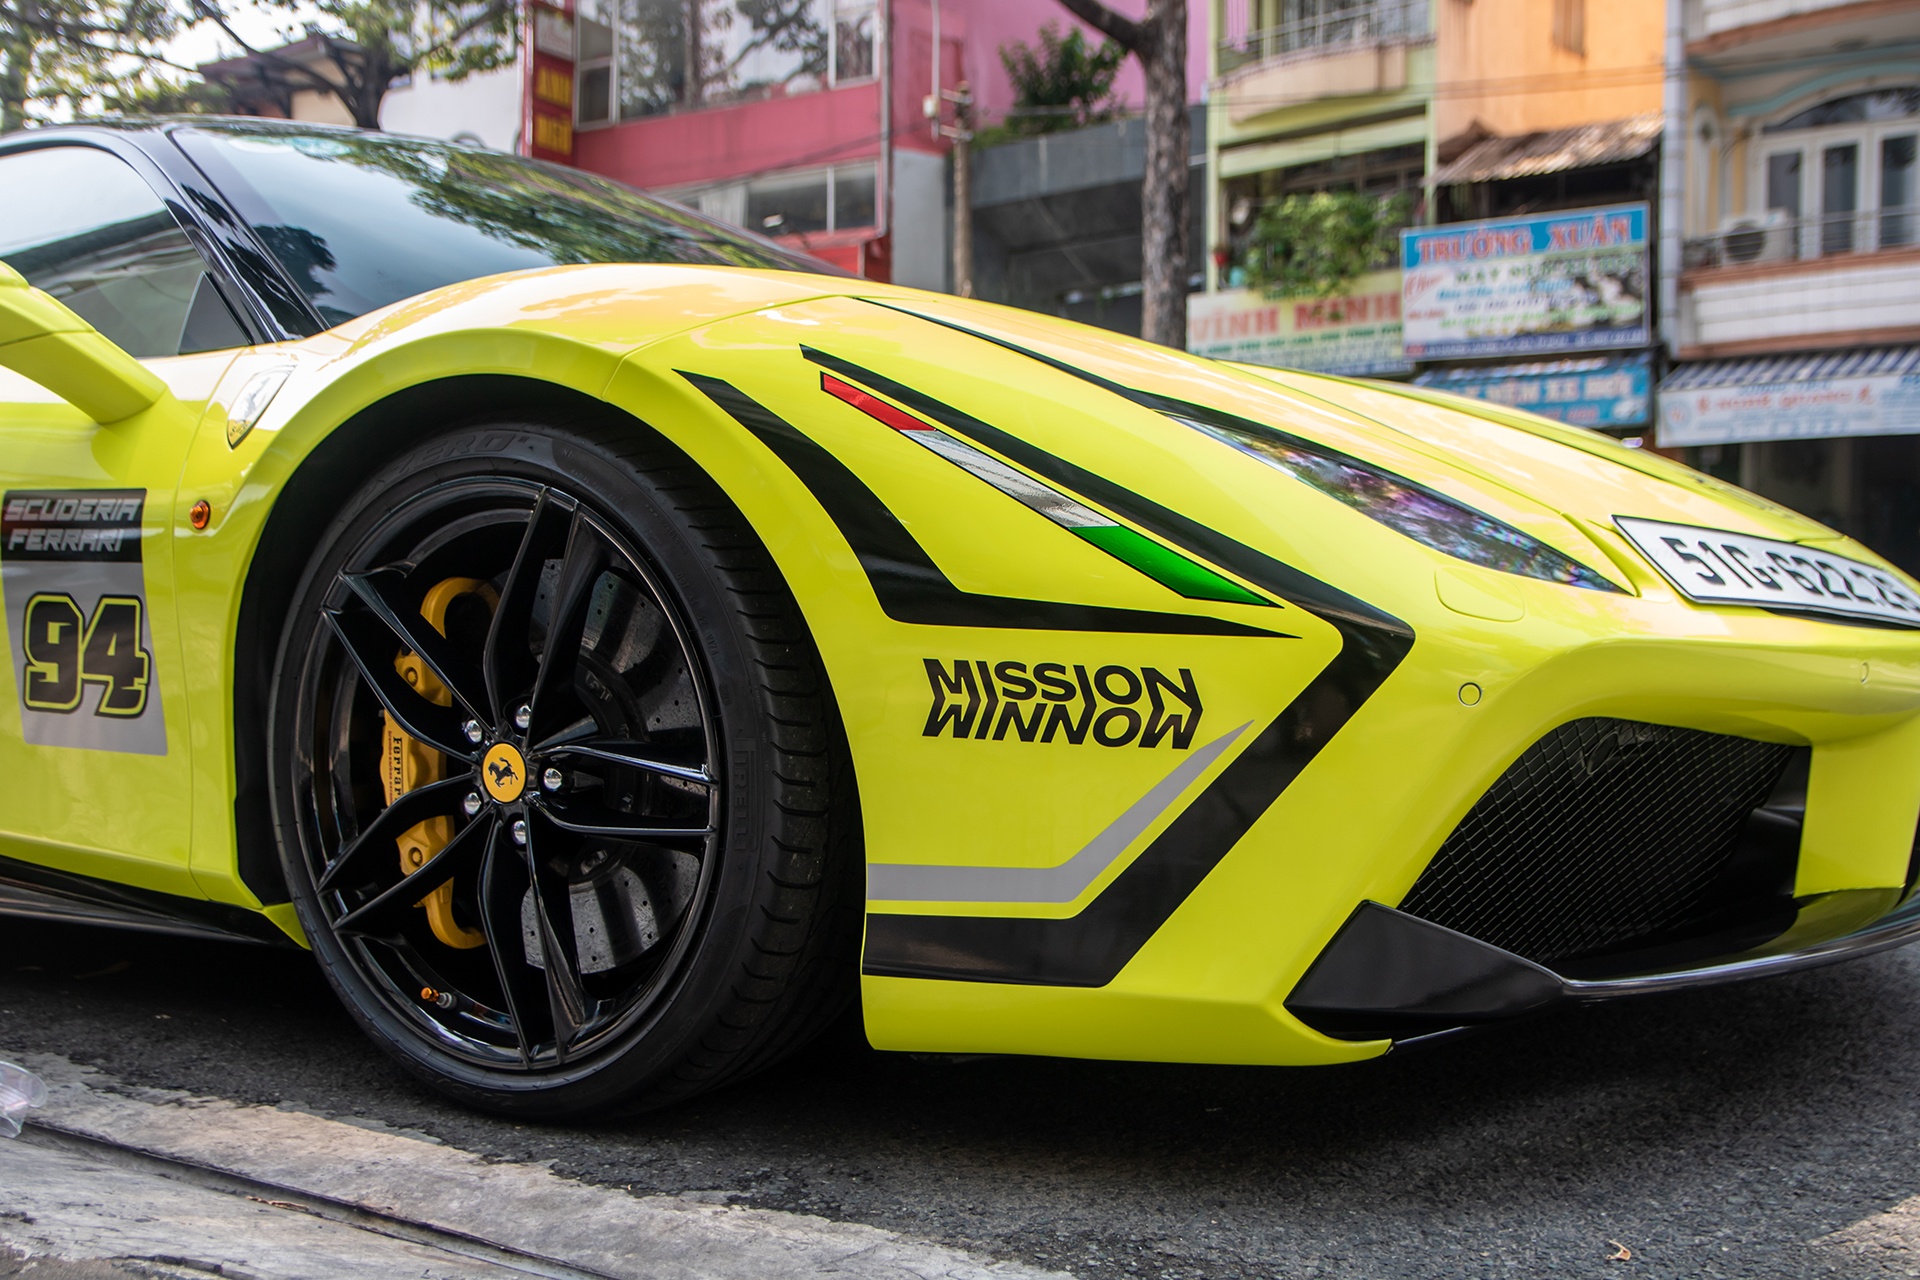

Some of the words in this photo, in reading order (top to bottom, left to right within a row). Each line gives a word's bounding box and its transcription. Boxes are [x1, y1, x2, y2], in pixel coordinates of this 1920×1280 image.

[4, 498, 142, 522] SCUDERIA
[8, 529, 126, 553] FERRARI
[22, 591, 152, 719] 94
[922, 658, 1203, 710] MISSION
[922, 698, 1203, 750] WINNOW
[393, 736, 403, 802] Ferrar
[733, 738, 757, 851] PIRELLI
